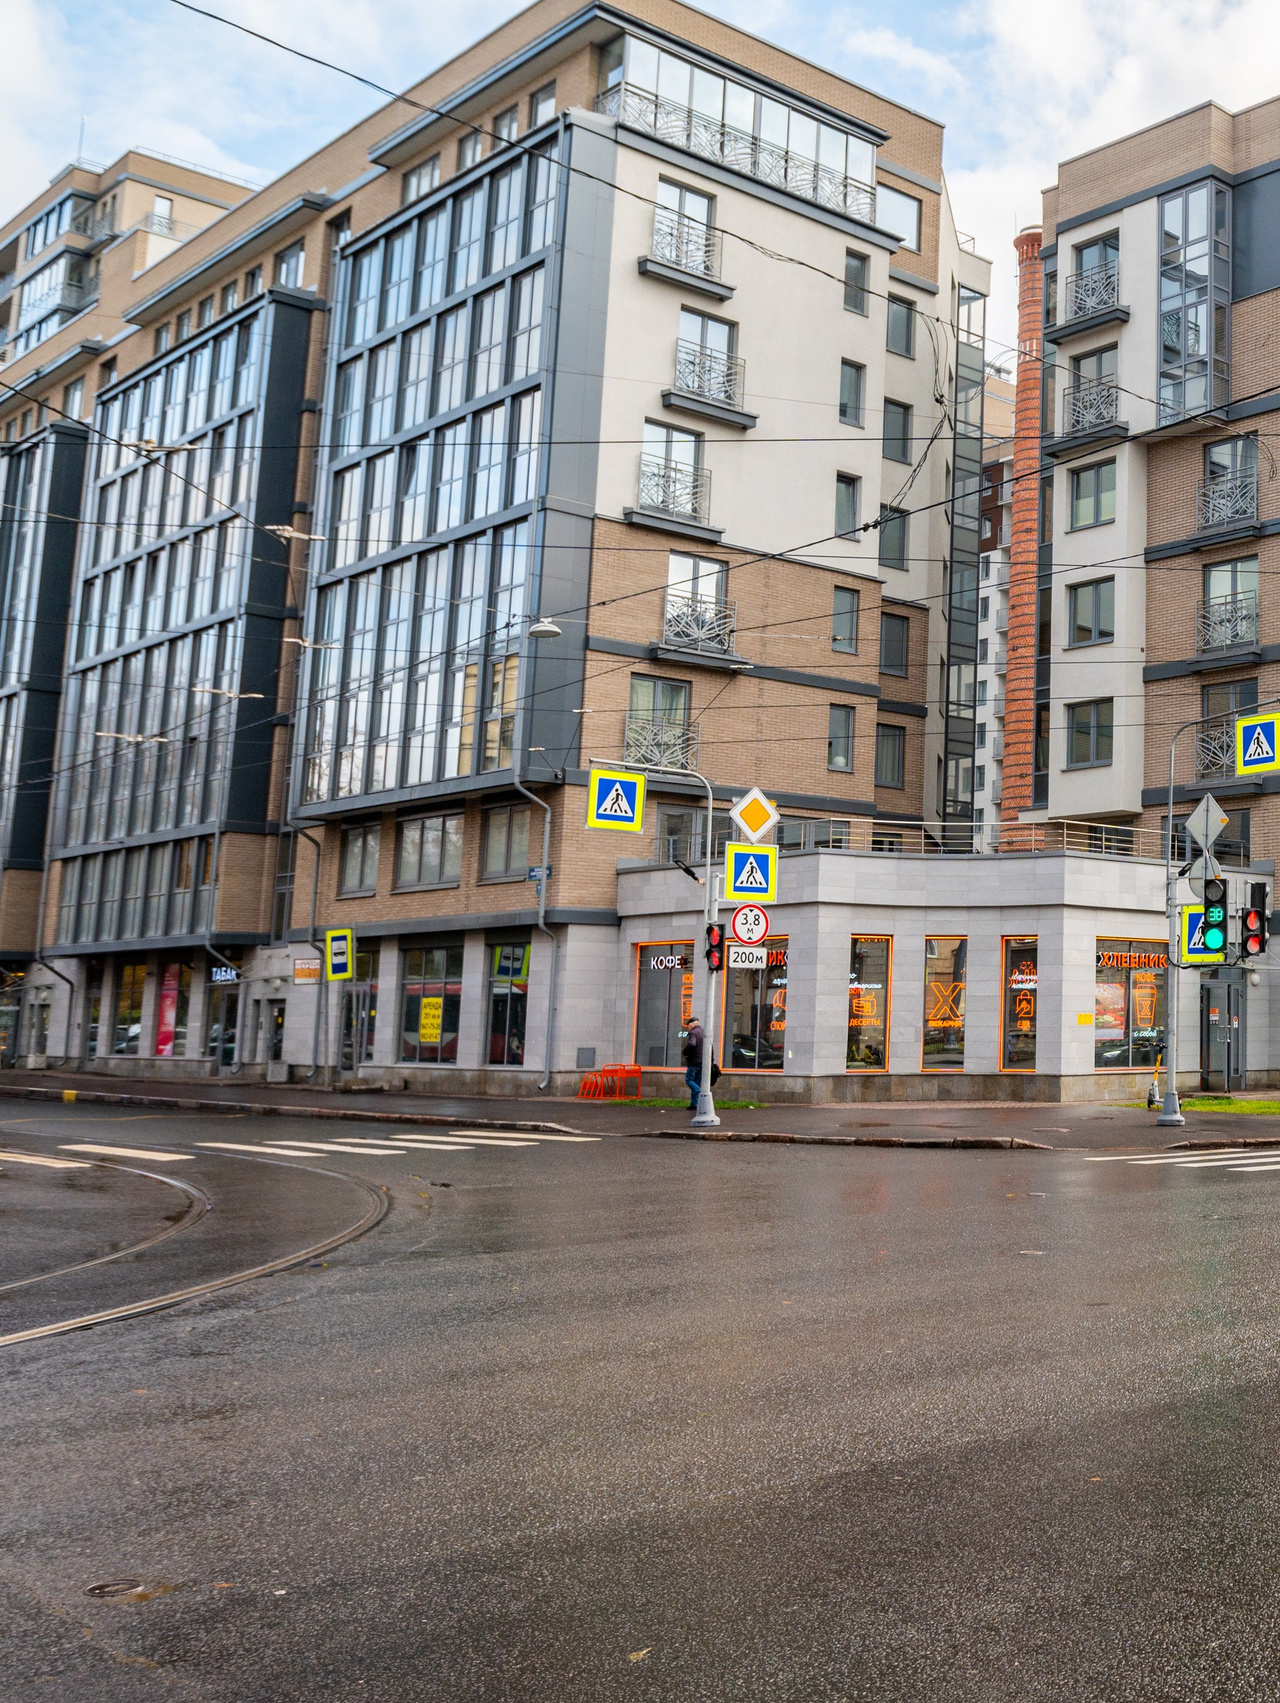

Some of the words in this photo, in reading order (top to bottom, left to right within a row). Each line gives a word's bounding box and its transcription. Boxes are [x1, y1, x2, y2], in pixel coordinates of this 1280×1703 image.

[740, 913, 761, 926] 3.8
[1209, 907, 1223, 921] 38
[650, 955, 682, 970] КОФЕ
[1099, 951, 1169, 969] ХЛЕБНИК
[211, 966, 237, 982] ТАБАК
[1135, 972, 1157, 983] КОФЕ
[849, 1018, 881, 1027] ДЕСЕРТЫ
[928, 1020, 963, 1028] ПЕКАРНЯ
